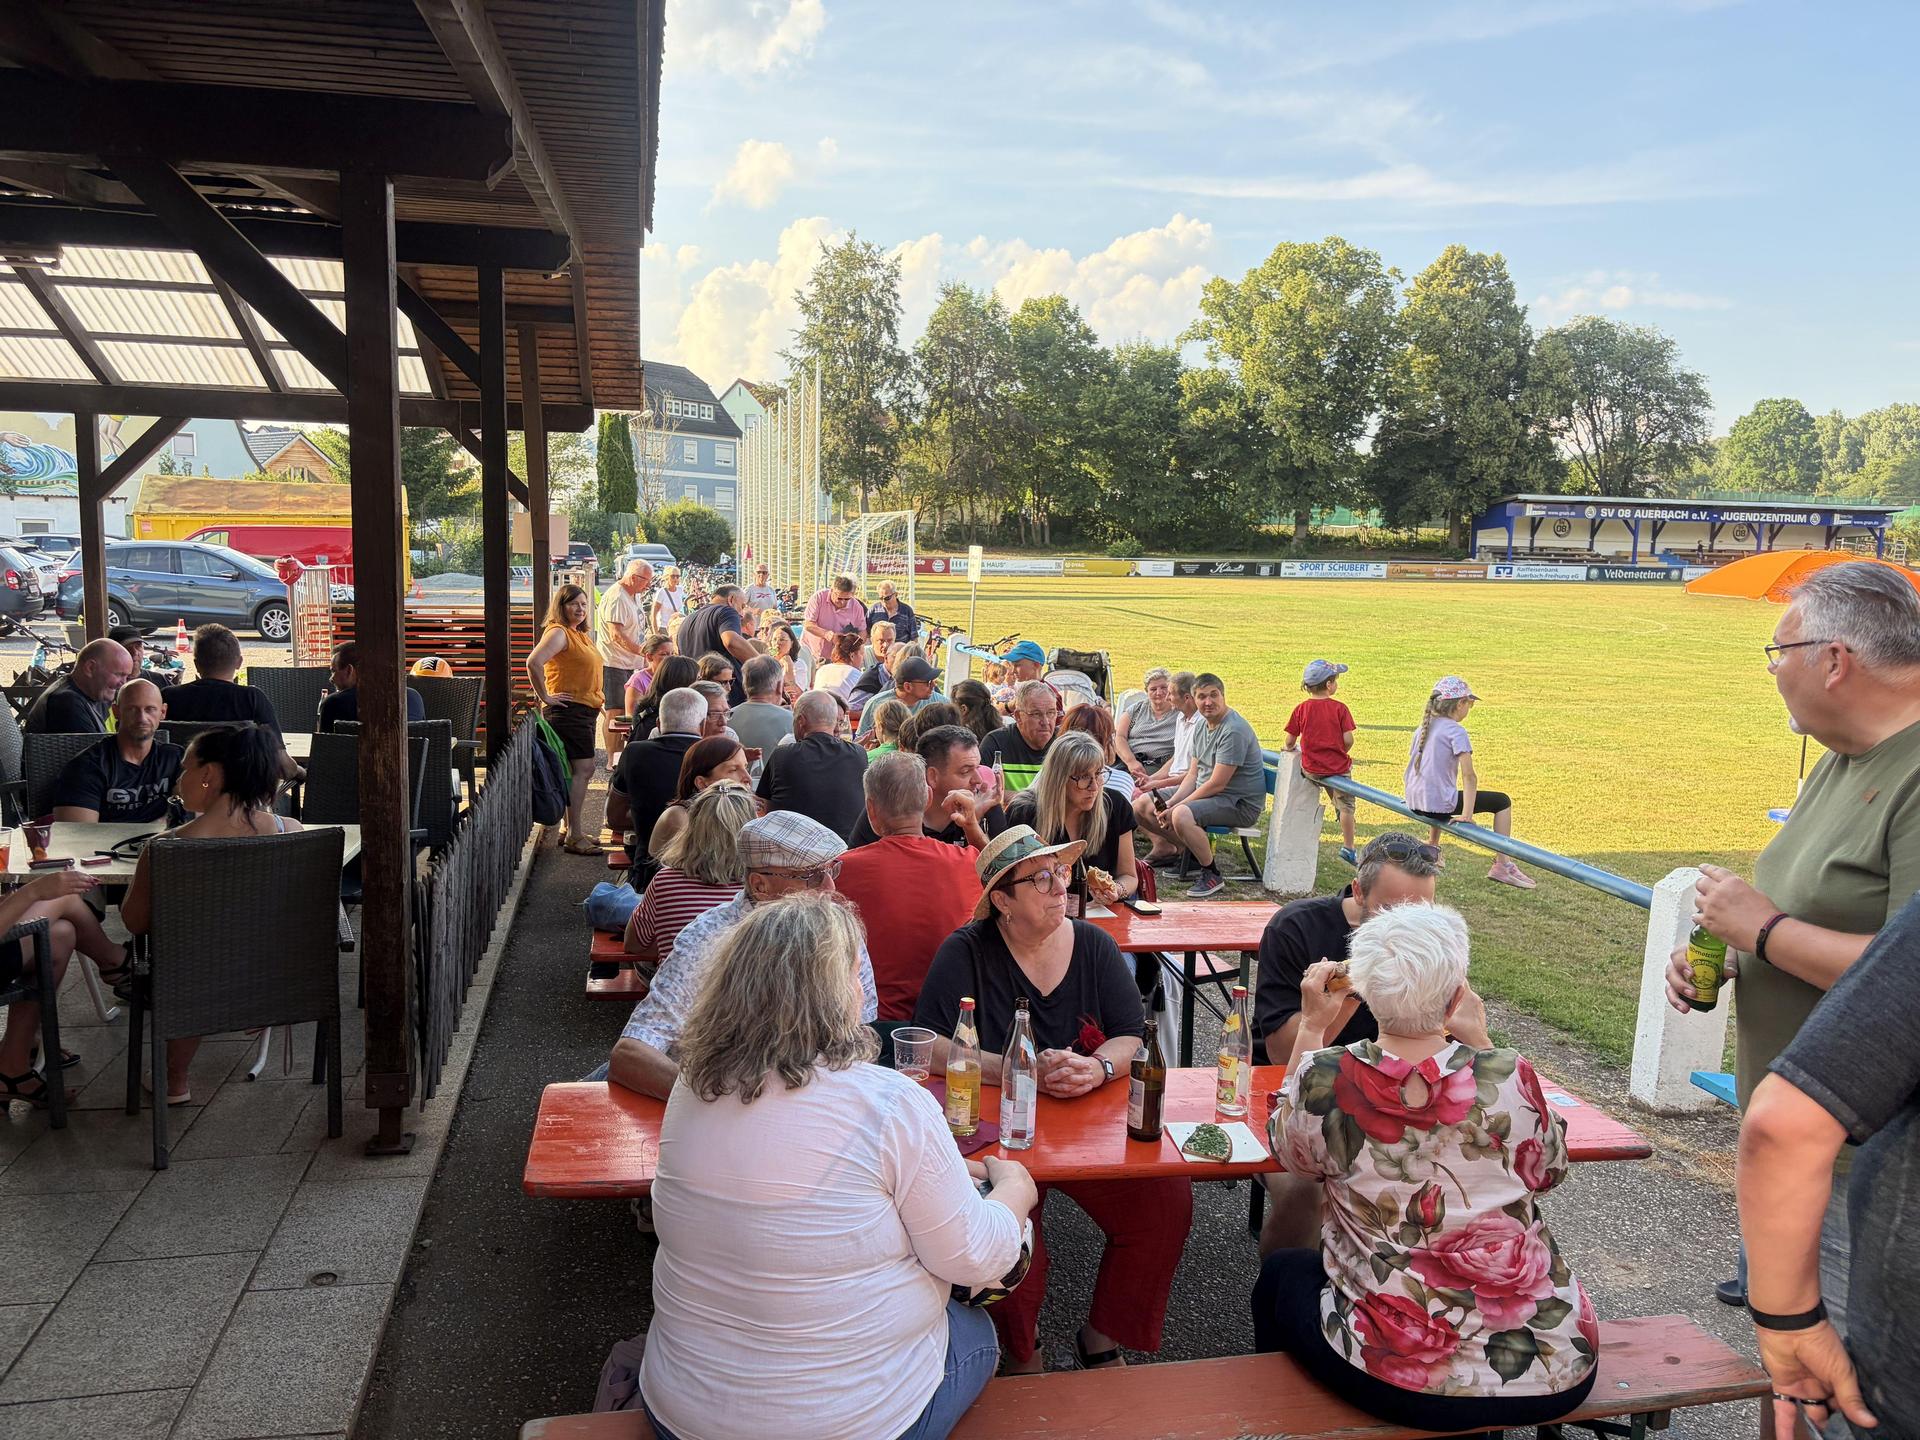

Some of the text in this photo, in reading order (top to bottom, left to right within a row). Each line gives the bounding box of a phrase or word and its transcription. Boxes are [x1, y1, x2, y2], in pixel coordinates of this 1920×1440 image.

[1600, 508, 1615, 518] SV
[1617, 508, 1631, 518] 08
[1634, 508, 1689, 520] AUERBACH
[1691, 510, 1710, 520] e.V.
[1720, 511, 1807, 523] JUGENDZENTRUM
[1556, 525, 1567, 533] 08
[1735, 529, 1747, 538] 08
[1299, 563, 1370, 572] SPORT SCHUBERT
[1604, 568, 1666, 579] Veldensteiner
